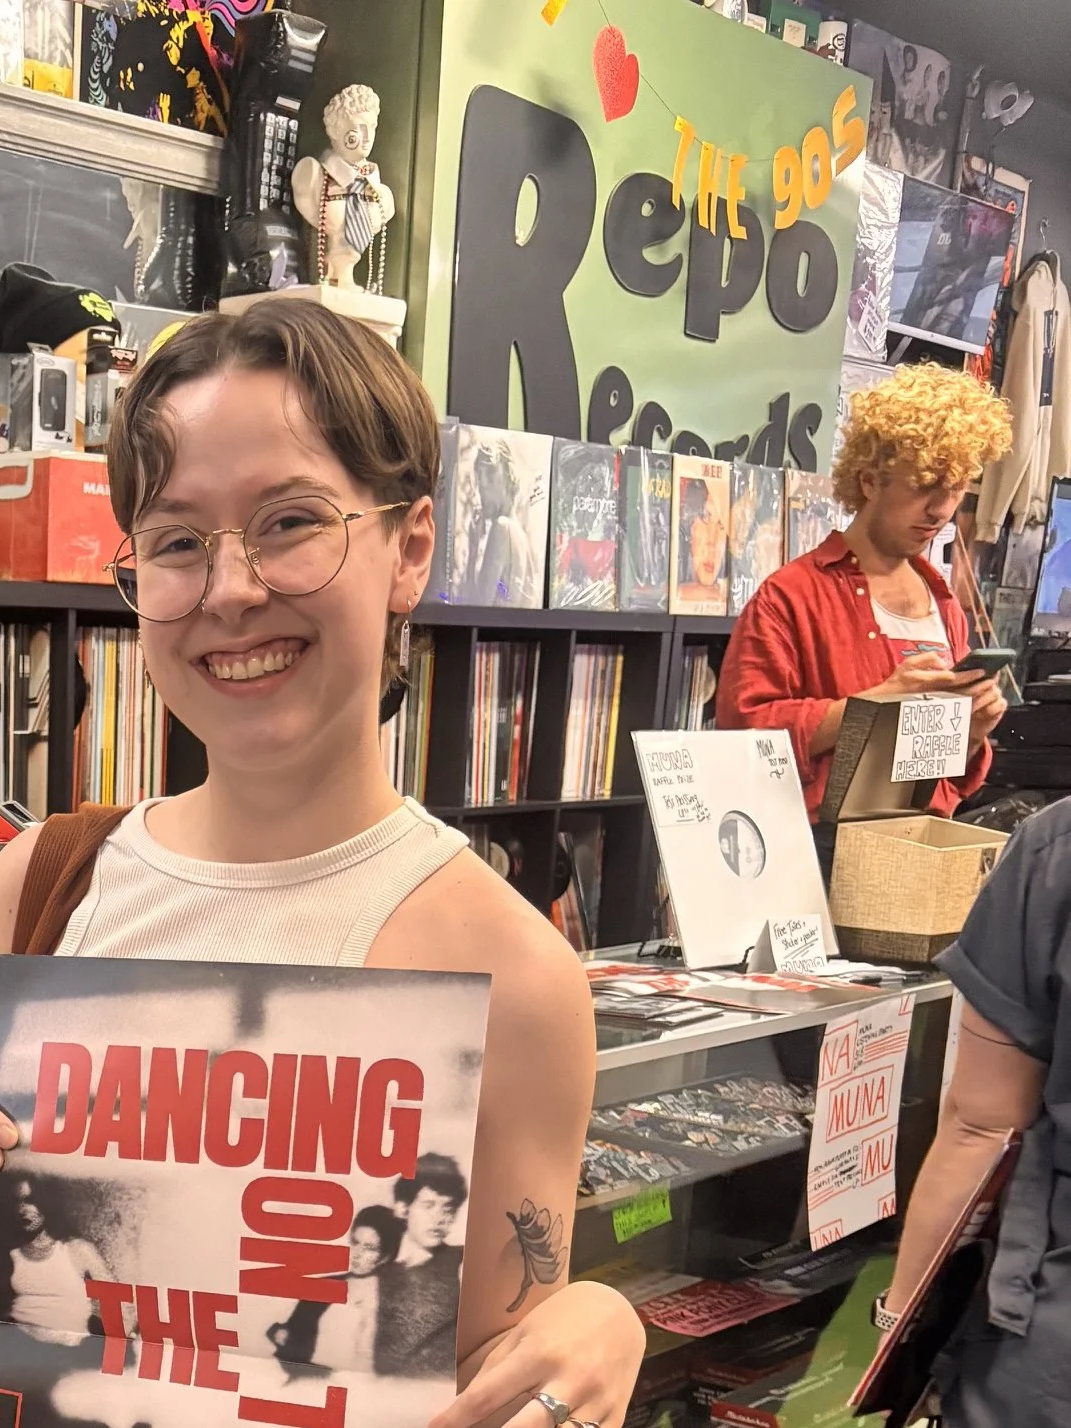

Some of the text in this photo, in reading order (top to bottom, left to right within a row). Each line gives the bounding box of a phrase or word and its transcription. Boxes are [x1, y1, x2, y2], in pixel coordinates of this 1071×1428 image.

[671, 117, 747, 240] THE
[572, 495, 617, 516] paramore
[901, 703, 946, 736] ENTER
[645, 748, 694, 773] MUNA
[912, 733, 961, 760] RAFFLE
[31, 1041, 425, 1180] DANCING
[829, 1075, 886, 1133] MUNA
[863, 1134, 895, 1180] MU
[239, 1176, 355, 1304] ON
[85, 1280, 239, 1392] THE
